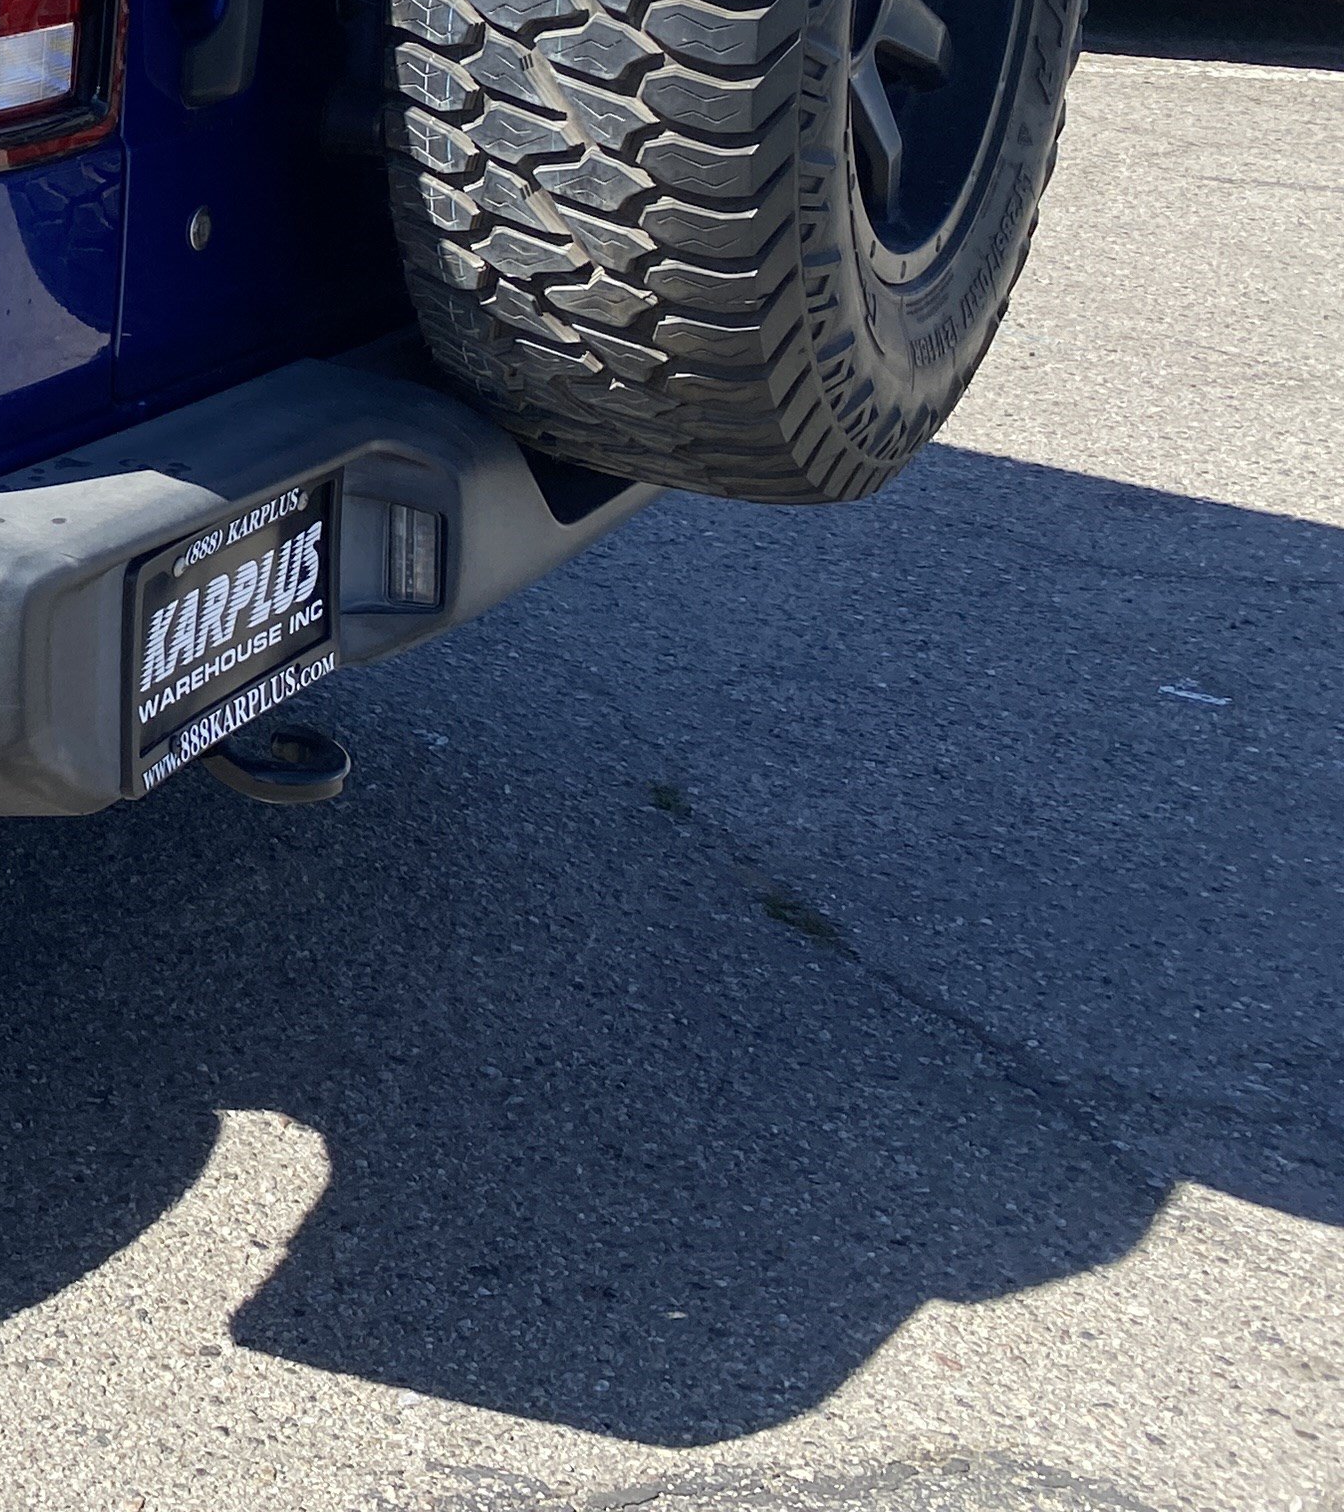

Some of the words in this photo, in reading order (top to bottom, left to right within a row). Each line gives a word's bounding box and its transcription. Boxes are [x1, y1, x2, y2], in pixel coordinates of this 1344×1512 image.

[184, 529, 224, 567] (888)
[226, 488, 300, 546] KARPLUS
[138, 622, 283, 724] WAREHOUSE
[288, 599, 324, 635] INC
[139, 520, 324, 692] KARPLUS
